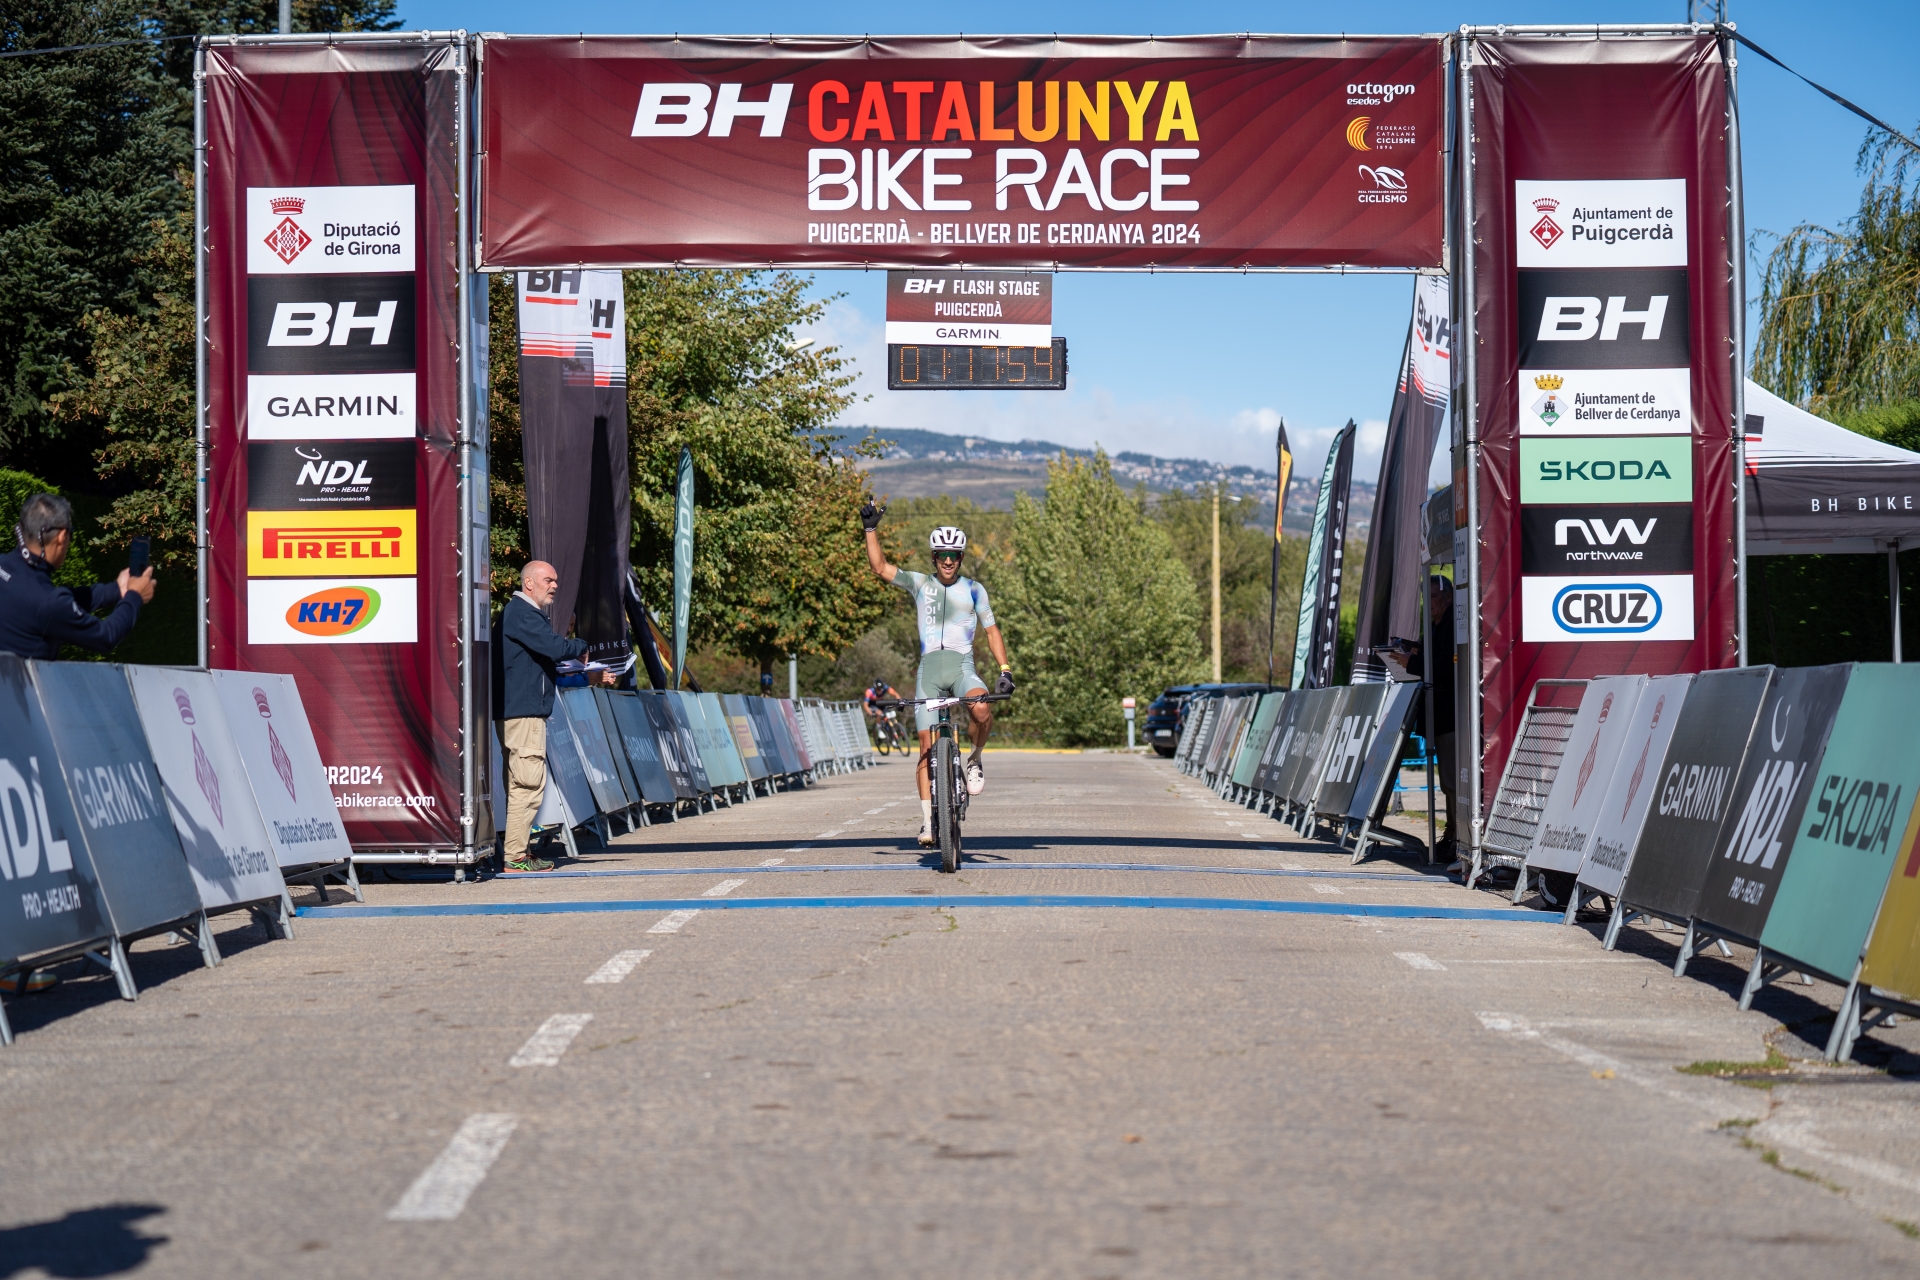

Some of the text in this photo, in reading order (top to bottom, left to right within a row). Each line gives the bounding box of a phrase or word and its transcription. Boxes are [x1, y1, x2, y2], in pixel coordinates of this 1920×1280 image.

[1346, 82, 1415, 103] octagon
[1346, 96, 1381, 106] esedos
[631, 80, 1200, 142] BH CATALUNYA
[807, 148, 1200, 211] BIKE RACE
[1358, 194, 1408, 203] CICLISMO
[1572, 207, 1673, 222] Ajuntament de
[323, 221, 401, 240] Diputació
[808, 218, 911, 244] PUIGCERDÀ
[931, 222, 1011, 244] BELLVER
[1027, 222, 1041, 244] DE
[1047, 222, 1145, 245] CERDANYA
[1151, 222, 1201, 245] 2024
[1572, 224, 1674, 245] Puigcerdà
[324, 241, 401, 256] de Girona
[904, 279, 1040, 296] BH FLASH STAGE
[934, 301, 1002, 317] PUIGCERDÀ
[1537, 295, 1669, 341] BH
[267, 301, 398, 347] BH
[936, 328, 1000, 340] GARMIN
[267, 395, 399, 417] GARMIN
[1575, 392, 1655, 408] Ajuntament de
[1575, 407, 1681, 422] Bellver de Cerdanya
[296, 460, 373, 485] NDL
[1811, 496, 1912, 512] BH BIKE
[263, 526, 402, 559] PIRELLI
[1566, 551, 1643, 560] northwave
[925, 586, 938, 646] GROOVE
[1562, 593, 1648, 624] CRUZ
[1325, 715, 1373, 784] BH
[73, 761, 158, 830] GARMIN
[1659, 762, 1731, 823] GARMIN
[0, 756, 73, 881] DL
[1724, 759, 1807, 870] NDL
[22, 891, 42, 920] PRO
[46, 884, 81, 916] HEALTH
